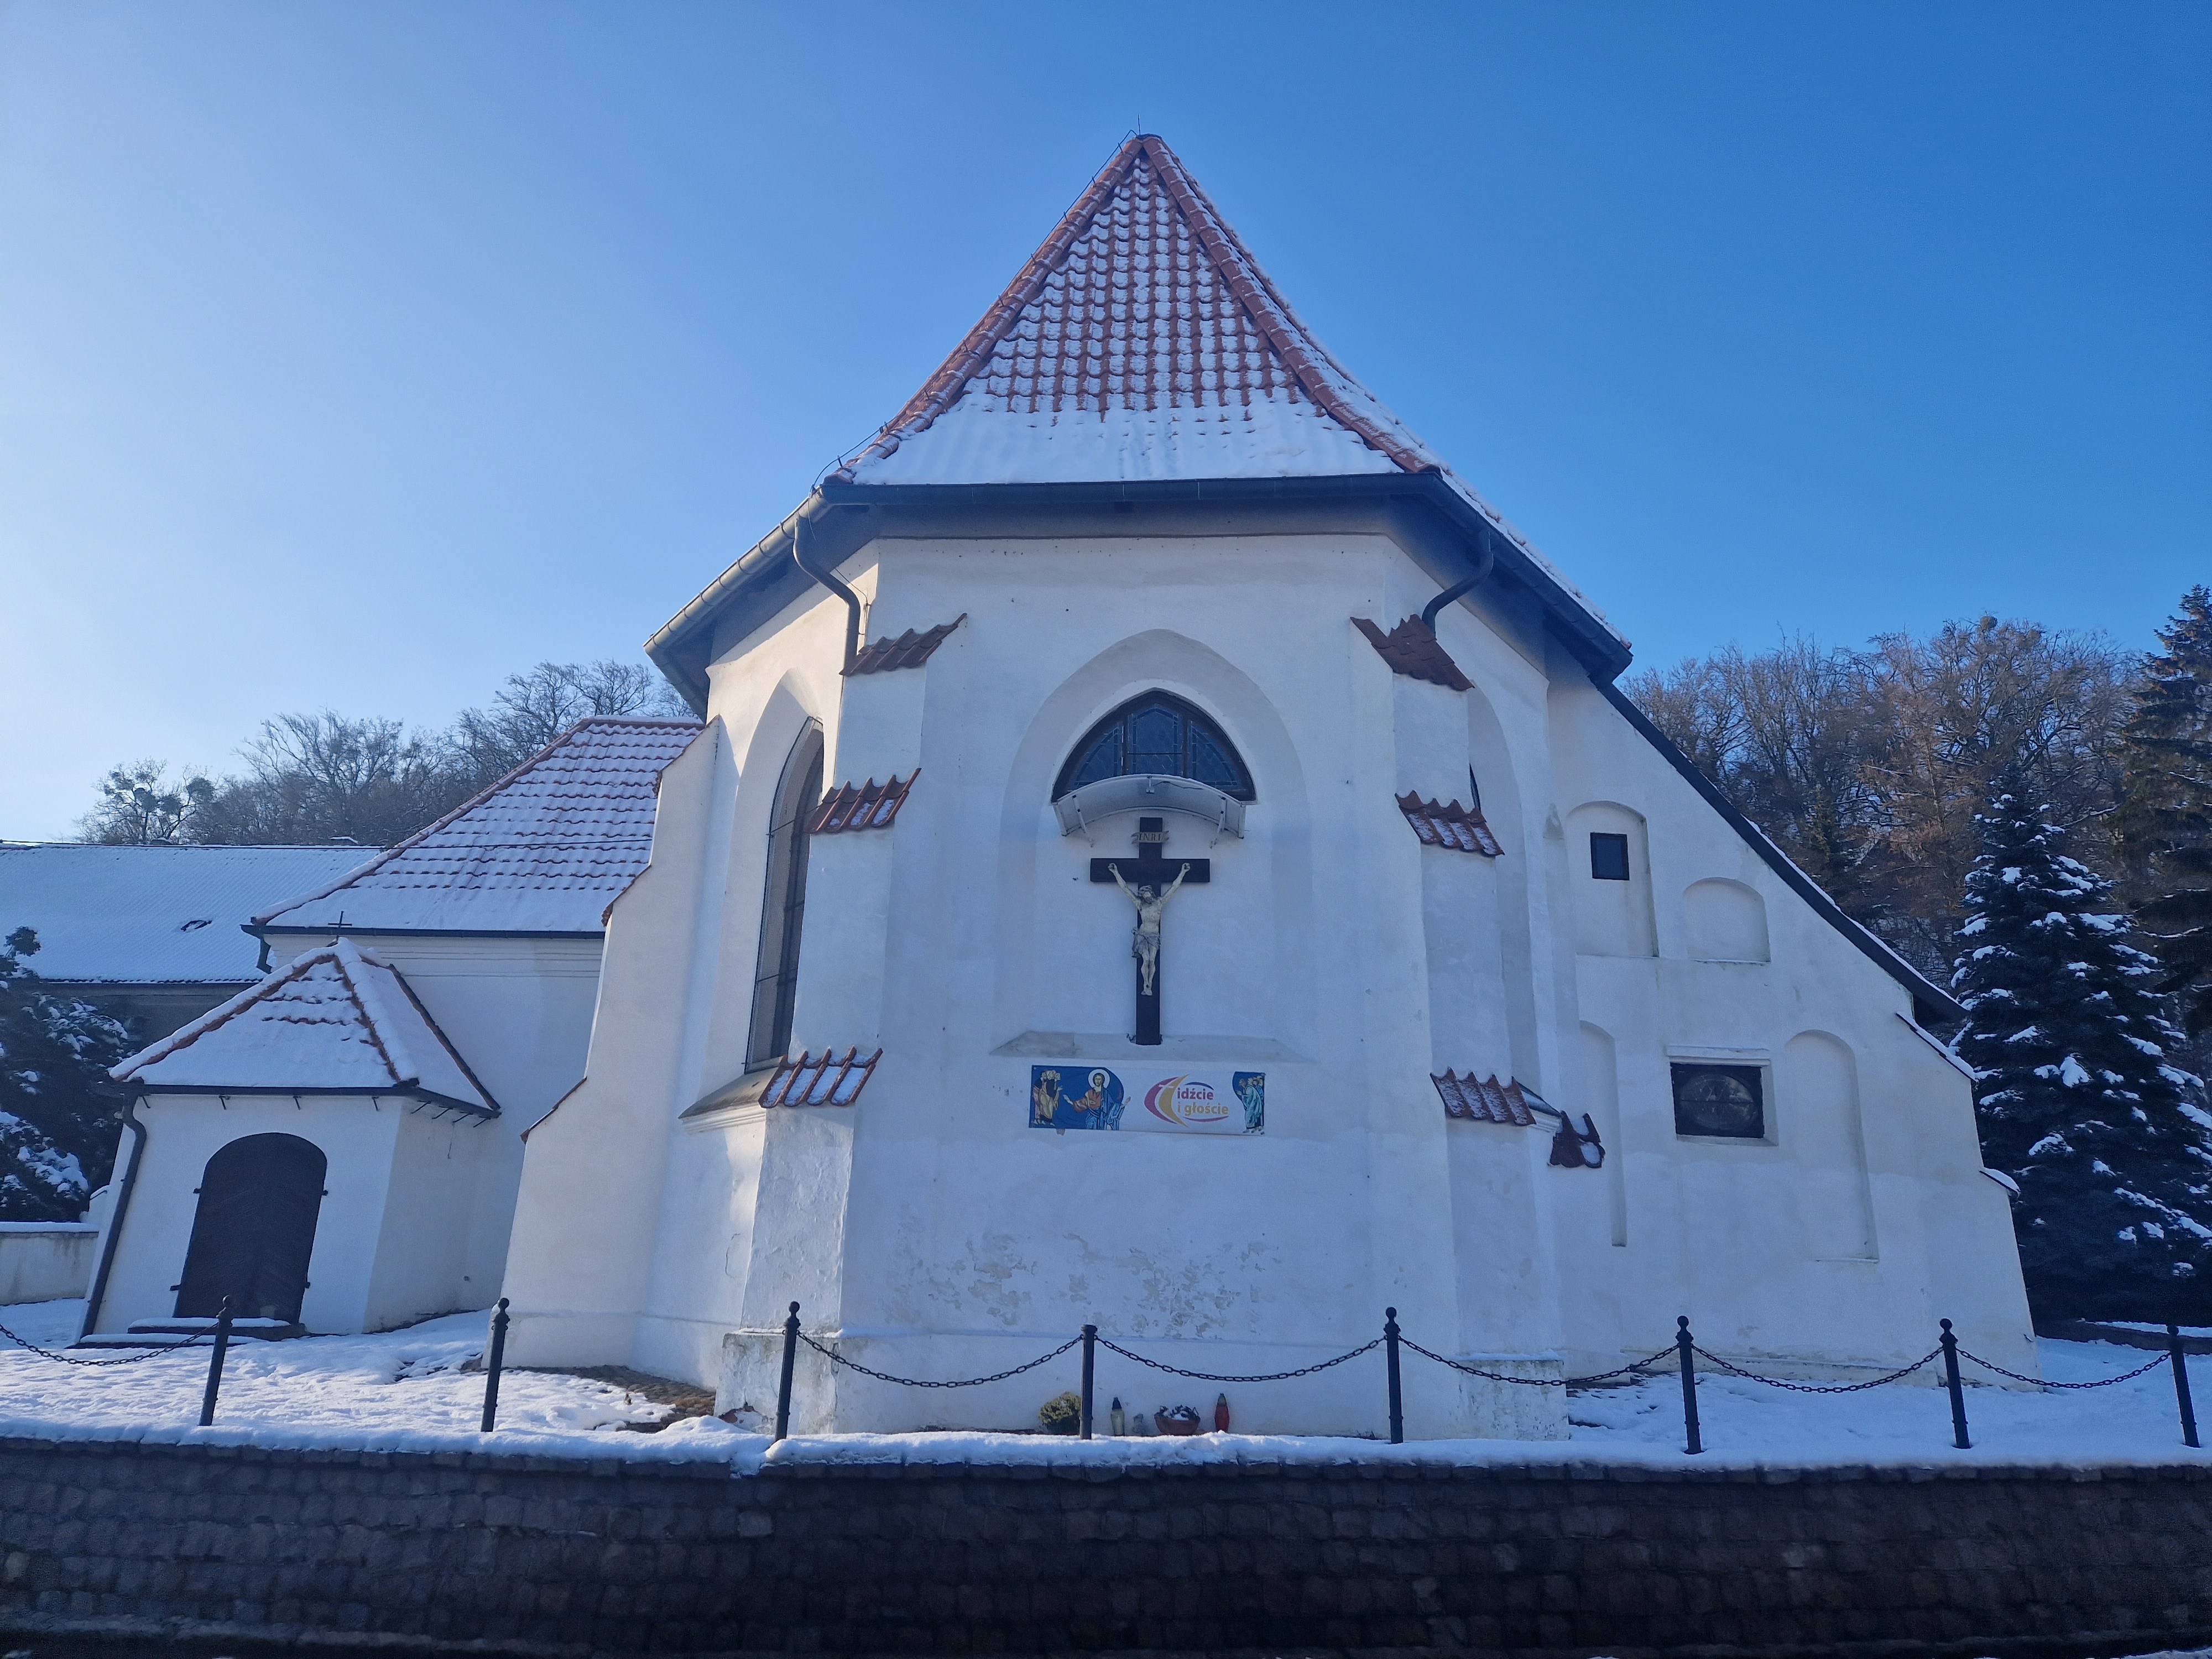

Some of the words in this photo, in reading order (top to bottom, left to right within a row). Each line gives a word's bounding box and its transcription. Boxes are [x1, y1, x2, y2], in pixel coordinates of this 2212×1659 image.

[1177, 1087, 1214, 1100] idźcie
[1177, 1102, 1181, 1113] i
[1184, 1102, 1229, 1116] głoście
